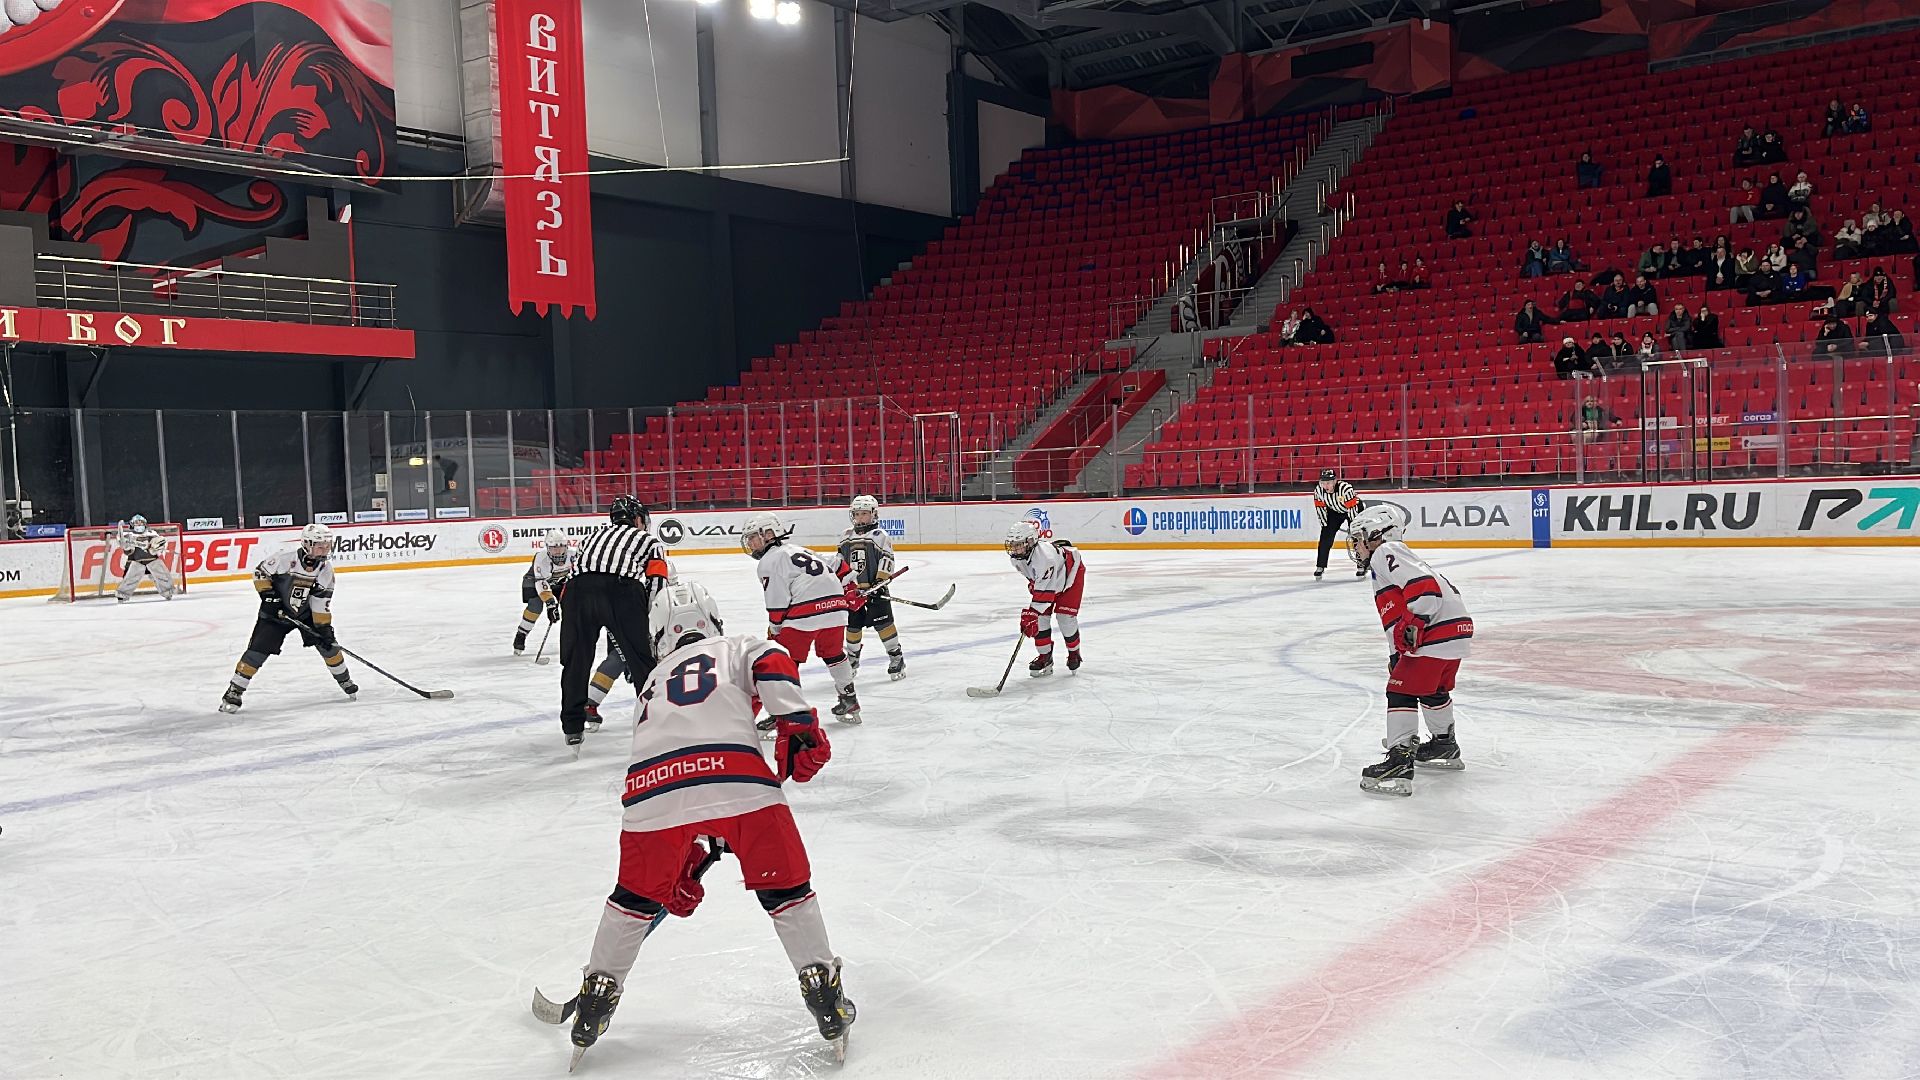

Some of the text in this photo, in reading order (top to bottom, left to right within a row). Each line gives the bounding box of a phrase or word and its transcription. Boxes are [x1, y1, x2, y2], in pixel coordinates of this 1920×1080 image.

[526, 13, 568, 277] ВИТЯЗЬ
[66, 313, 187, 345] БОГ
[1421, 504, 1510, 528] LADA
[1562, 491, 1761, 531] KHL.RU
[1386, 554, 1399, 572] 2
[625, 756, 725, 793] ПОДОЛЬСК
